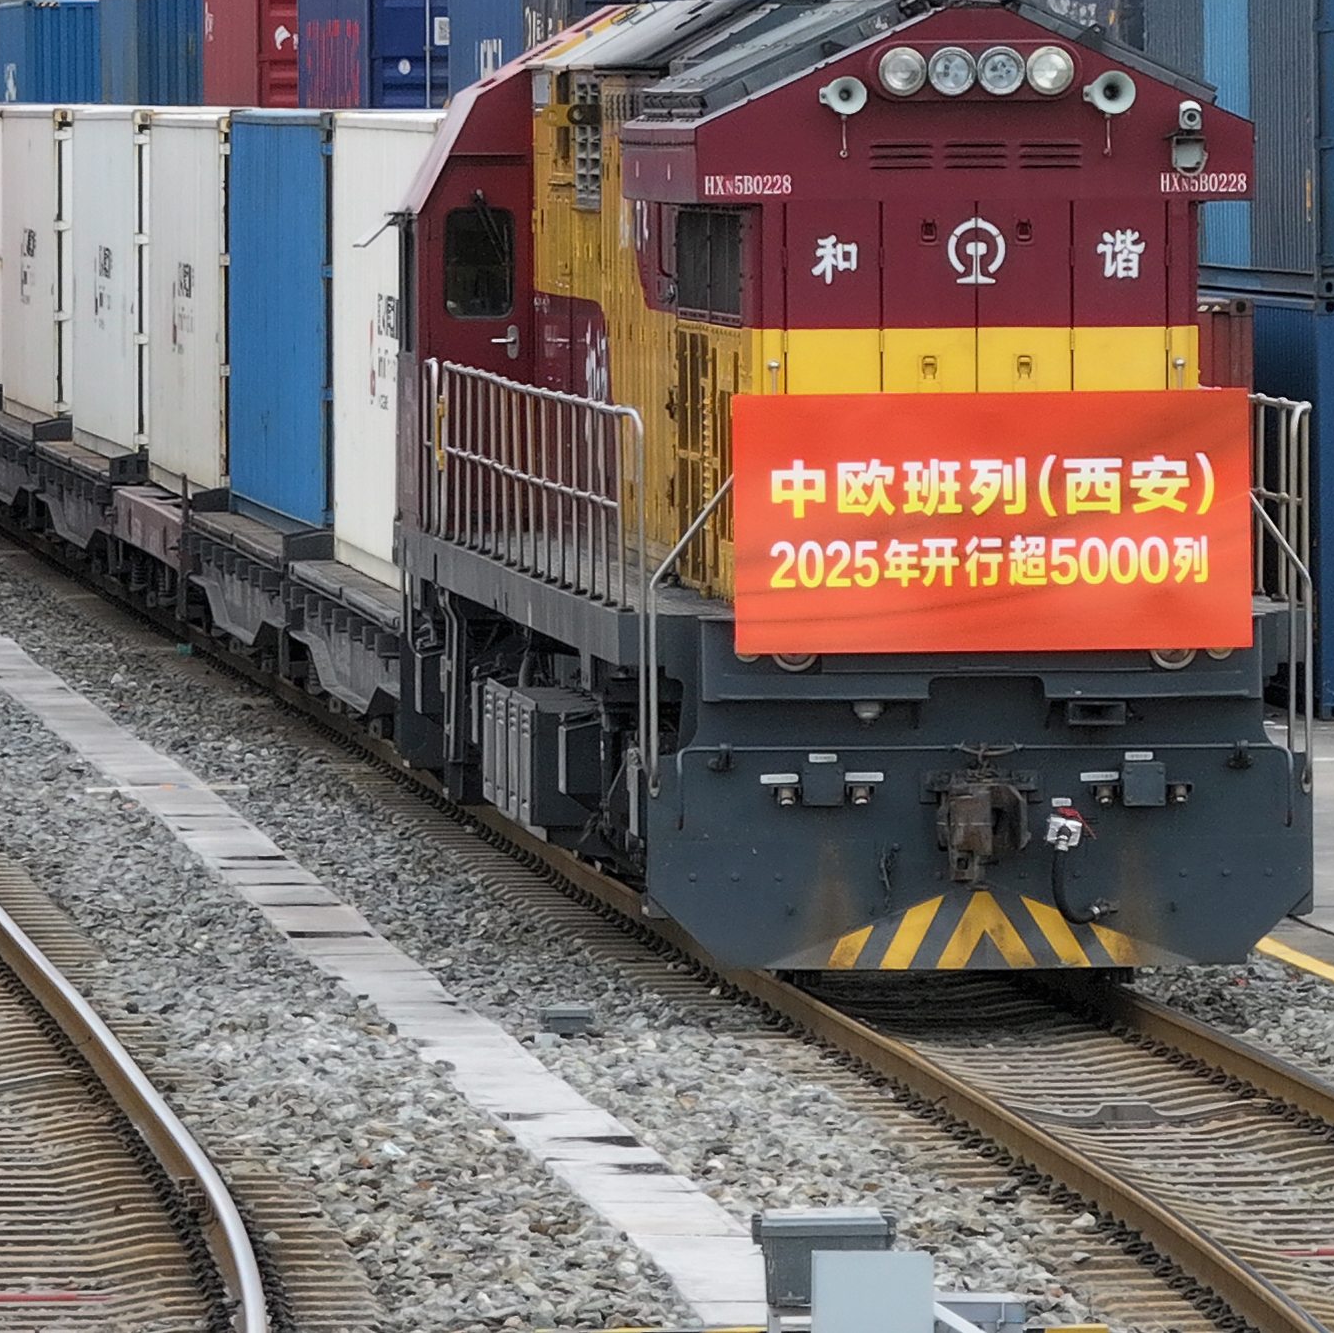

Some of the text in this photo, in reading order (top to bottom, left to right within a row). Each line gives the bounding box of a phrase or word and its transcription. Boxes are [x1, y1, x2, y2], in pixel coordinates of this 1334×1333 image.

[811, 229, 1146, 285] 和 谐
[769, 534, 1210, 589] 2025年开行超5000列
